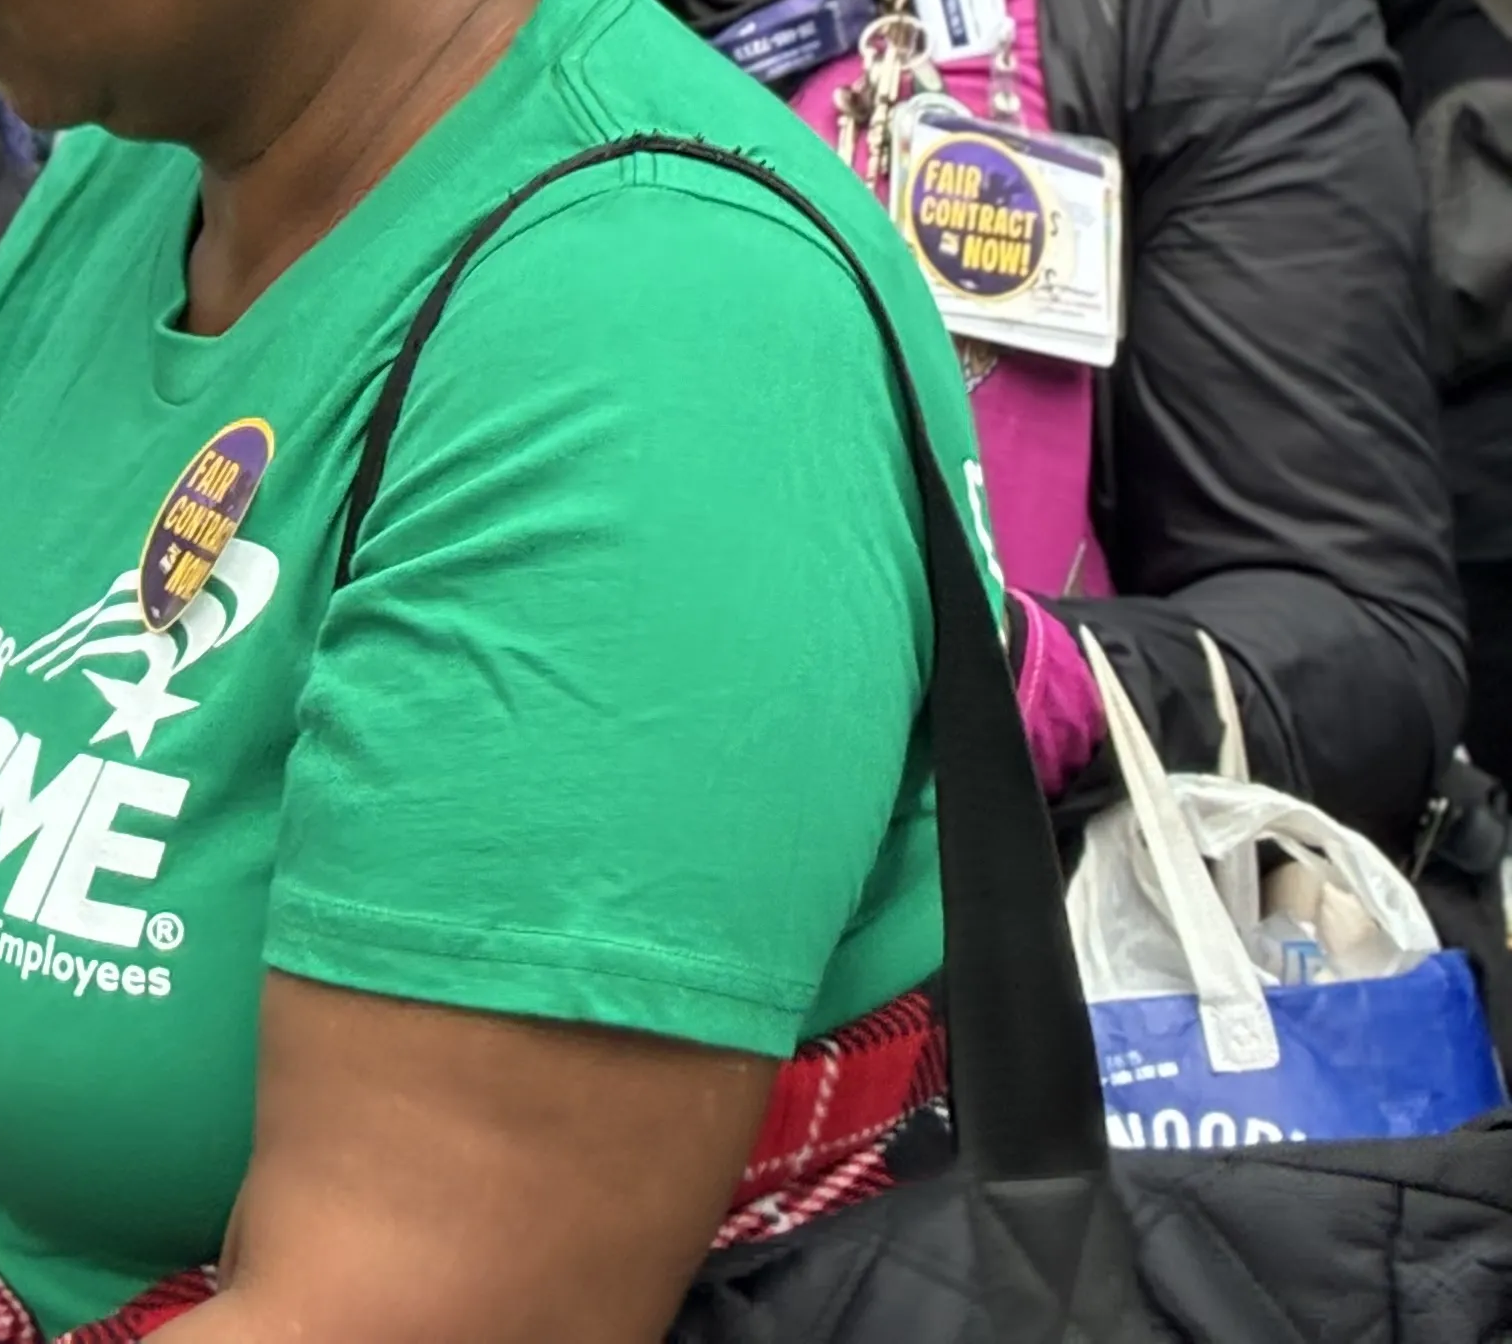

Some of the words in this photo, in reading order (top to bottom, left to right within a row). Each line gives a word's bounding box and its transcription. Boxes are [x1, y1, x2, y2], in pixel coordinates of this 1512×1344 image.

[924, 160, 983, 198] FAIR
[920, 195, 1039, 240] CONTRACT
[963, 236, 1034, 277] NOW!
[186, 449, 242, 505] FAIR
